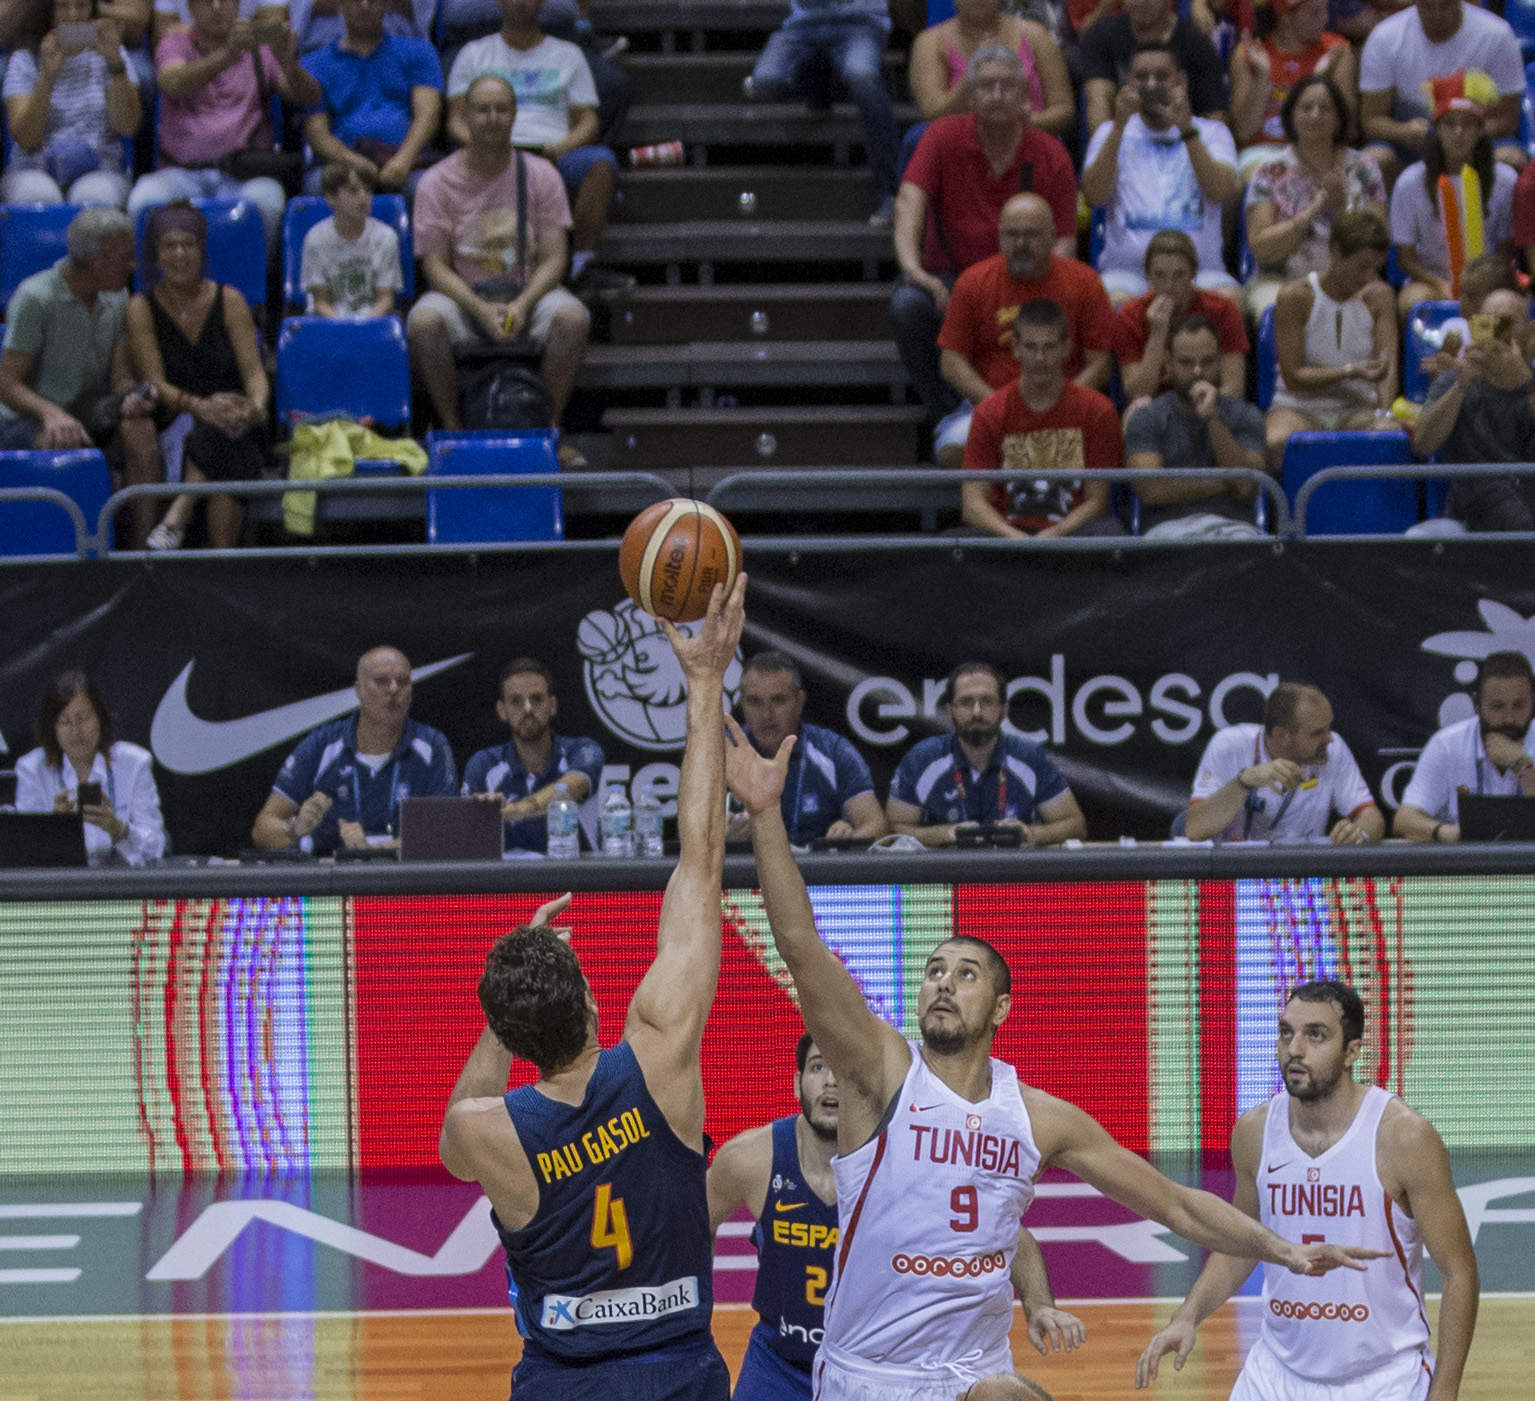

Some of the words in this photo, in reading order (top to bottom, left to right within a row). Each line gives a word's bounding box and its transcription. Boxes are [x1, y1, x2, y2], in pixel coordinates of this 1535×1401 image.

[537, 1142, 584, 1183] PAU
[581, 1107, 651, 1165] GASOL
[909, 1124, 1020, 1177] TUNISIA
[950, 1185, 979, 1232] 9
[1267, 1183, 1366, 1217] TUNISIA
[590, 1182, 633, 1271] 4
[773, 1219, 840, 1249] ESPA
[894, 1251, 1005, 1277] ooredoo
[575, 1285, 692, 1320] CaixaBank
[1271, 1300, 1368, 1321] ooredoo
